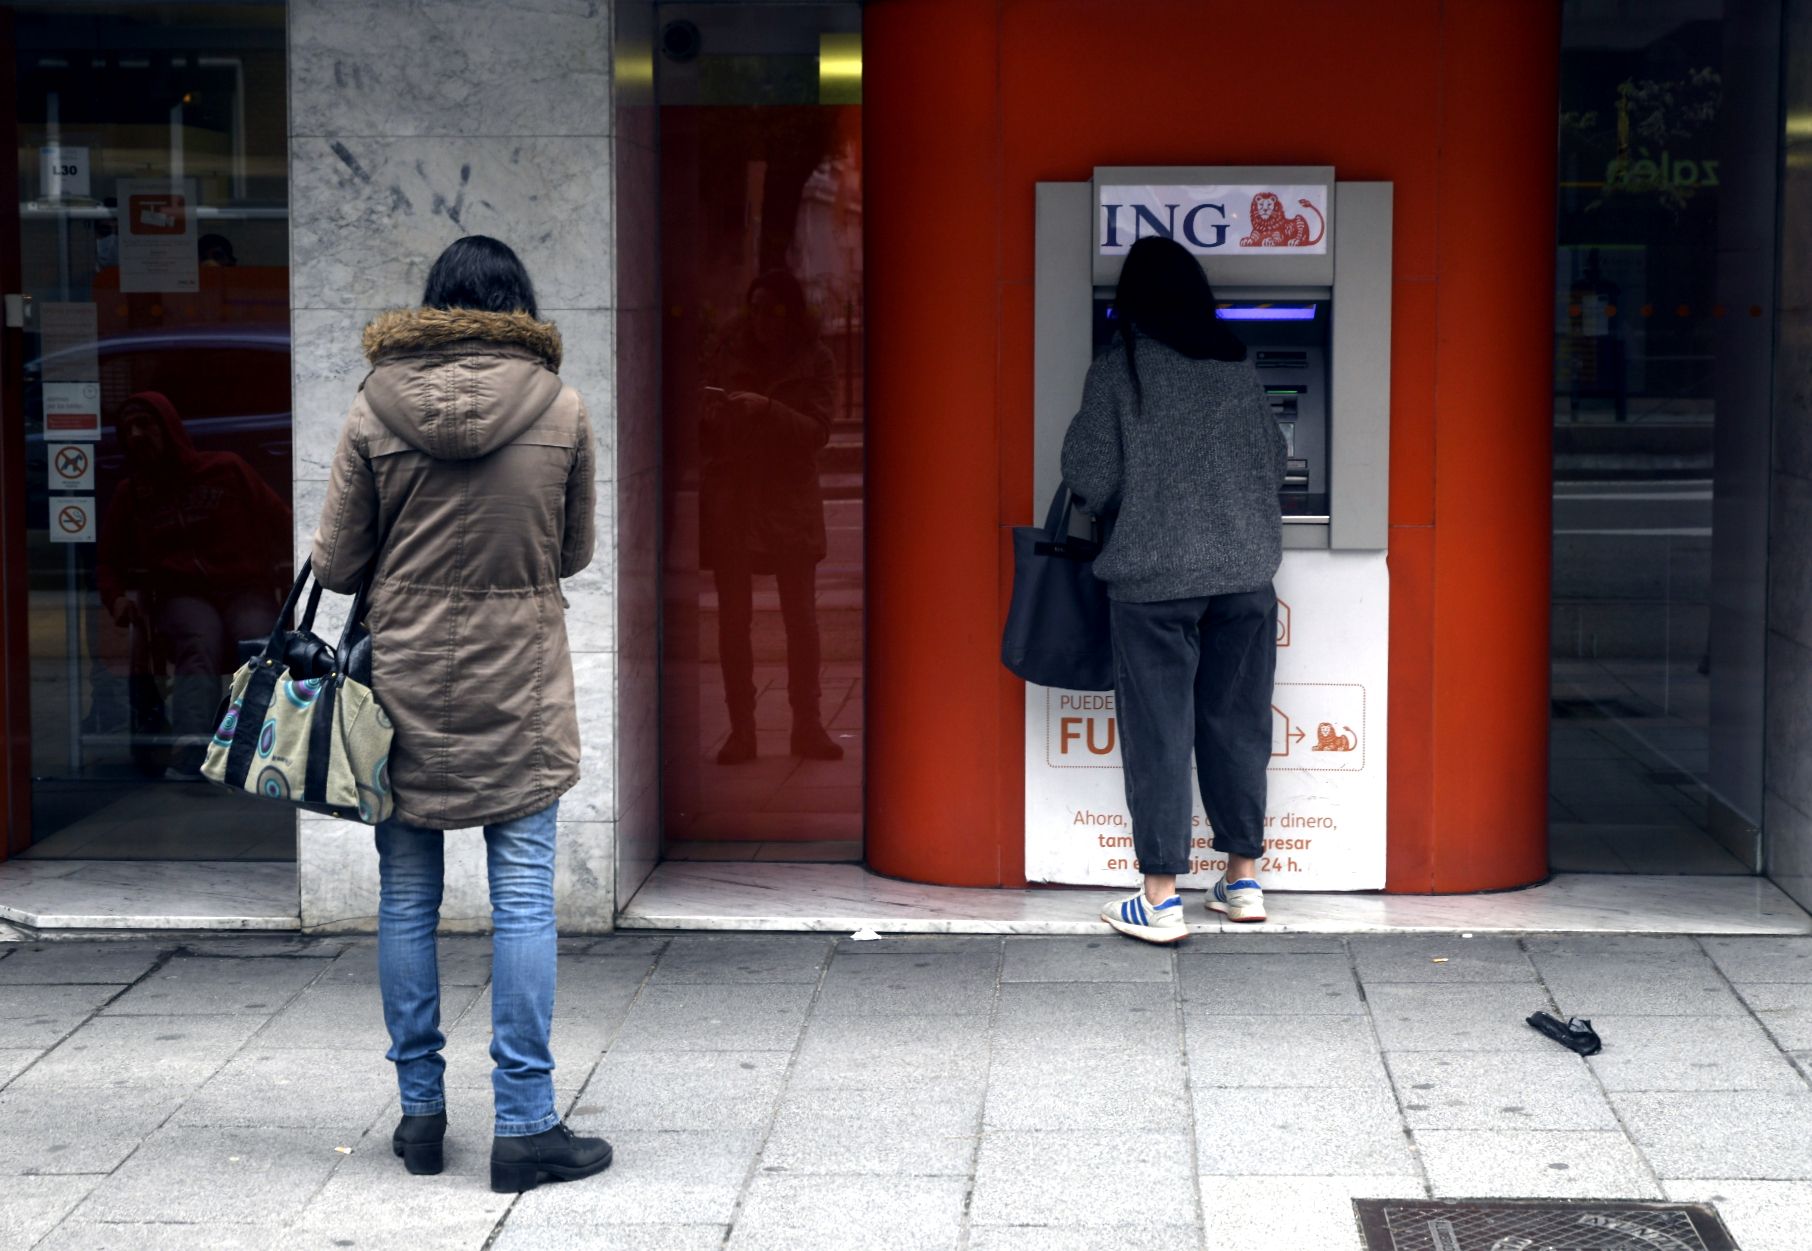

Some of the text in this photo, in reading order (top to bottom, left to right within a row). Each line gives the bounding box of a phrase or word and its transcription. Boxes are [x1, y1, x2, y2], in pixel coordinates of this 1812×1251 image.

[1101, 203, 1231, 248] ING
[1060, 695, 1114, 710] PUEDE
[1060, 717, 1116, 755] FU
[1073, 810, 1127, 828] Ahora,
[1280, 812, 1337, 831] dinero,
[1098, 834, 1133, 847] tam
[1107, 858, 1128, 870] en
[1261, 857, 1282, 872] 24
[1288, 857, 1302, 872] h.
